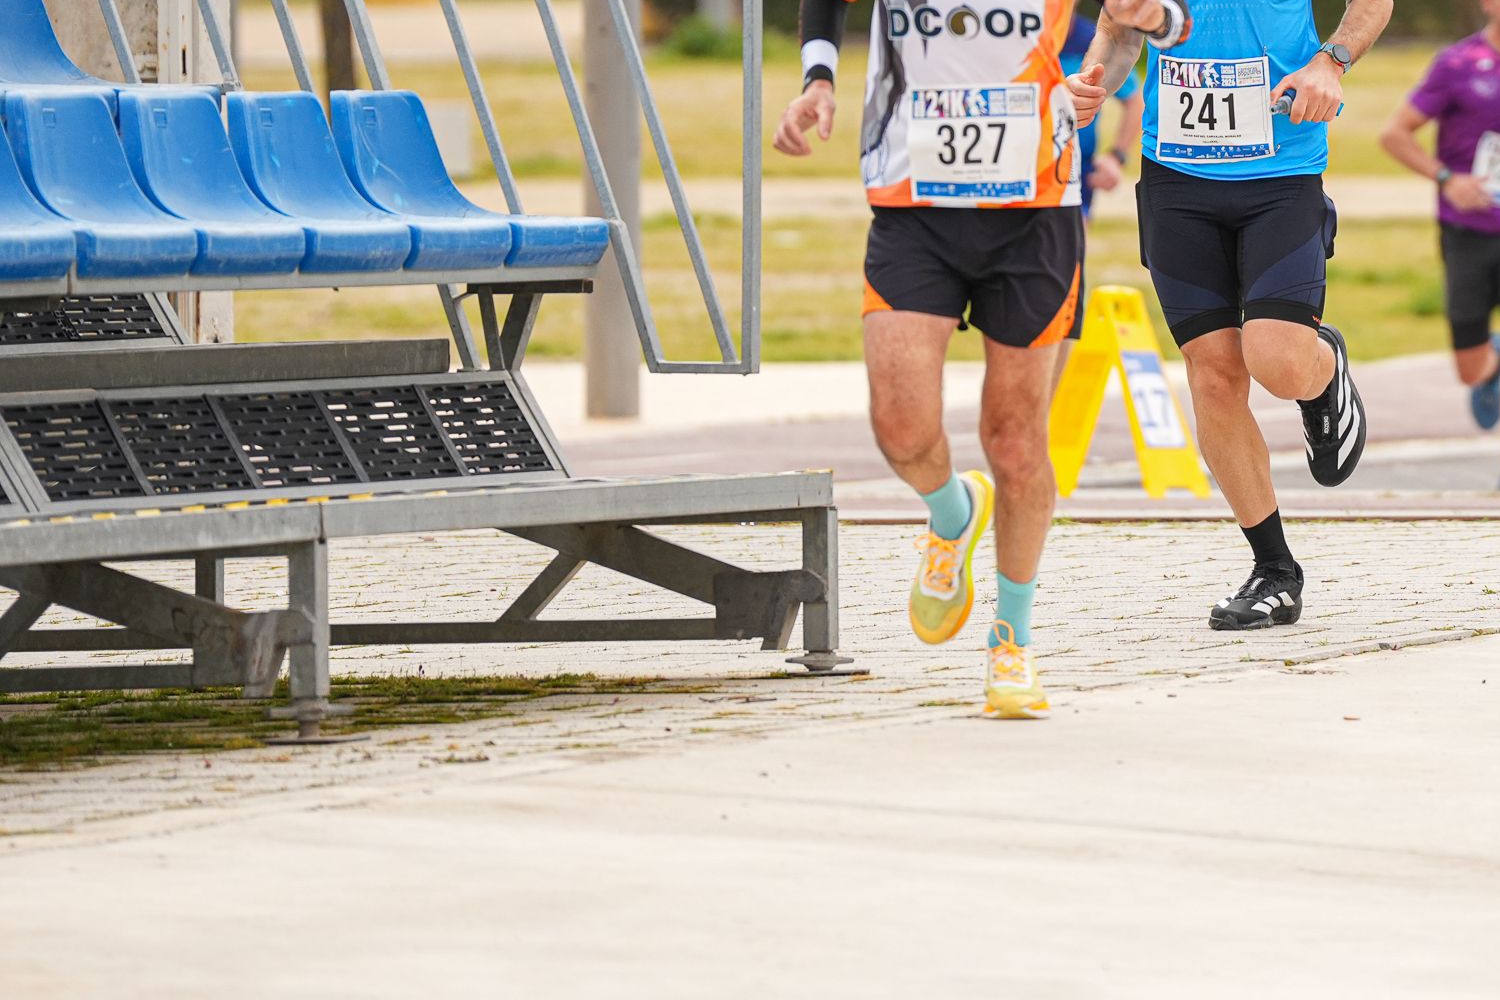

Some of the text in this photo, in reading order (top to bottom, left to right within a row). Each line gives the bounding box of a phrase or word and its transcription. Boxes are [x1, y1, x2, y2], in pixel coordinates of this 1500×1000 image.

[1170, 61, 1202, 88] 21K
[1179, 91, 1236, 131] 241
[937, 123, 1006, 165] 327
